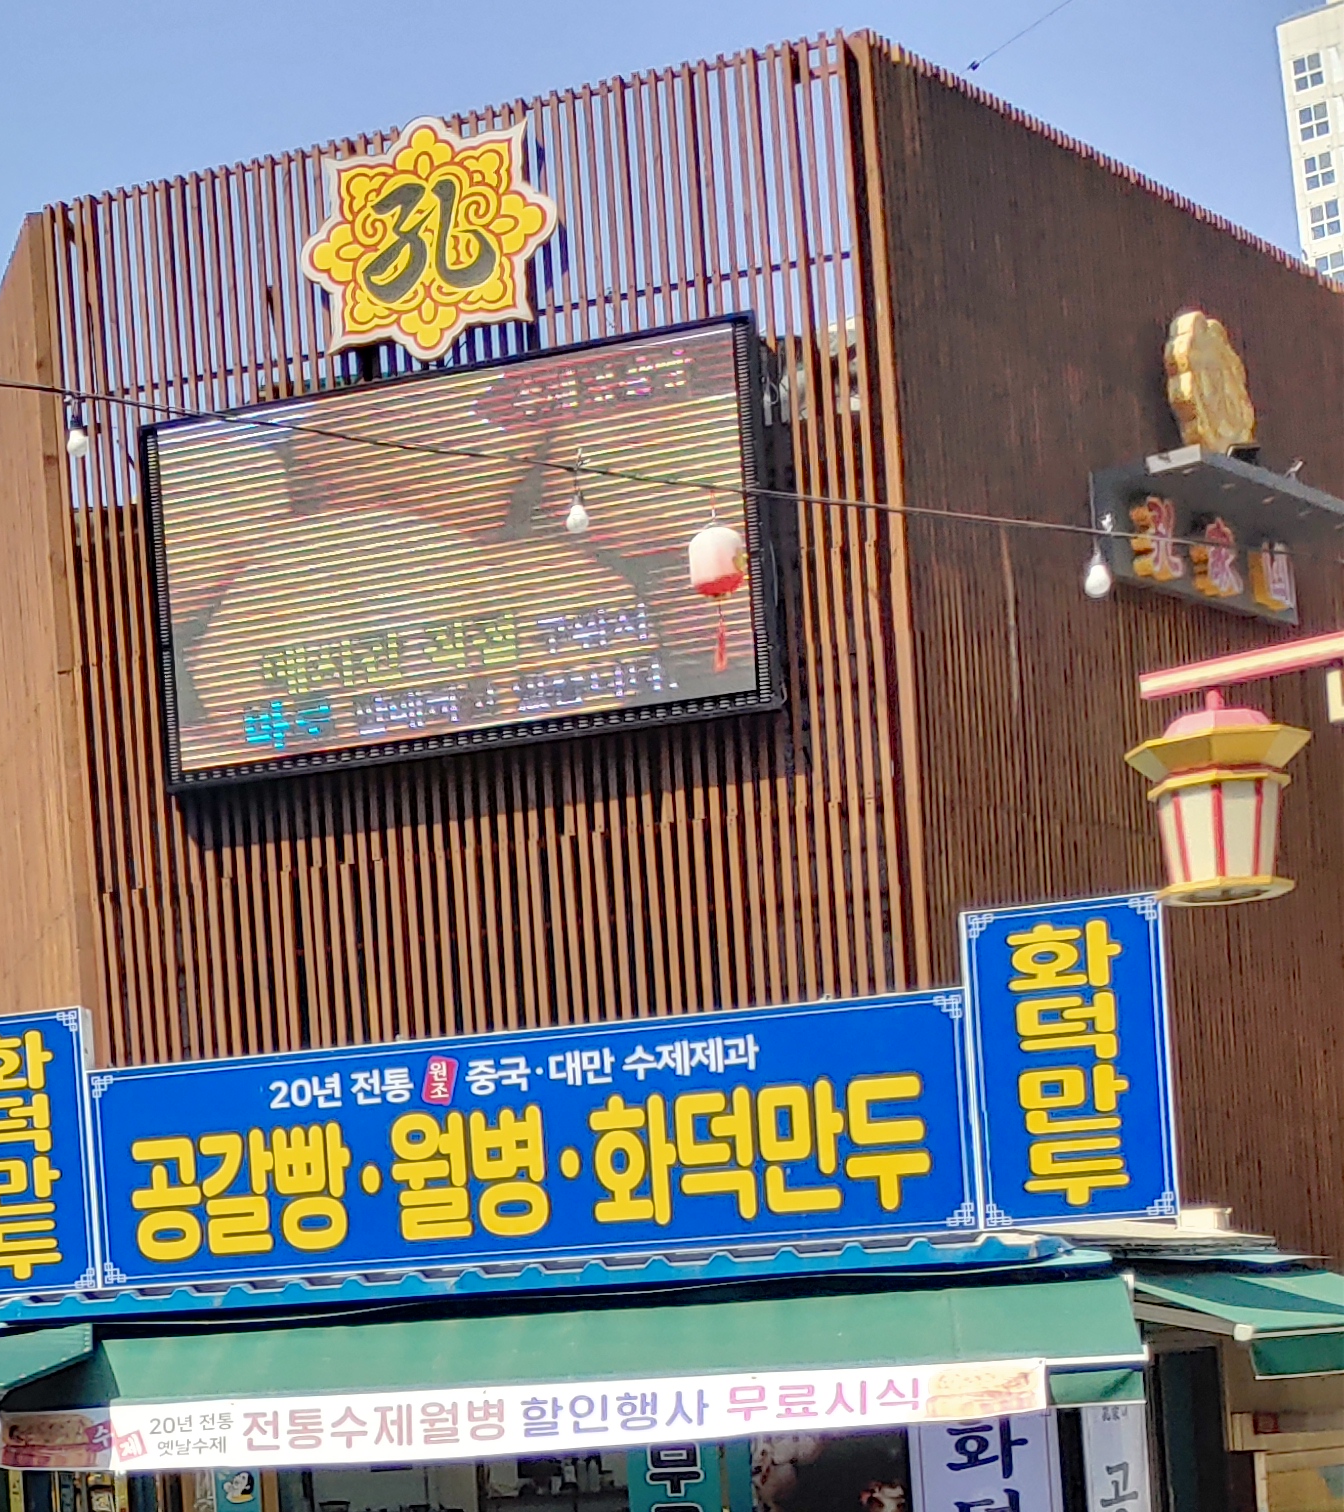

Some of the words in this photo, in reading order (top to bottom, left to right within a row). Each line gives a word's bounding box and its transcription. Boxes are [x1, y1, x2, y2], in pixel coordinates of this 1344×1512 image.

[362, 180, 498, 301] 孔
[268, 1073, 343, 1110] 20년
[350, 1067, 413, 1106] 전통
[428, 1061, 452, 1101] 원조
[622, 1033, 760, 1082] 수제제과
[1007, 919, 1130, 1206] 화덕만두
[149, 1414, 193, 1435] 20년
[198, 1409, 234, 1433] 전통
[155, 1435, 229, 1459] 옛날수제
[242, 1396, 506, 1452] 전통수제월병
[520, 1388, 710, 1439] 할인행사
[726, 1377, 922, 1423] 무료시식
